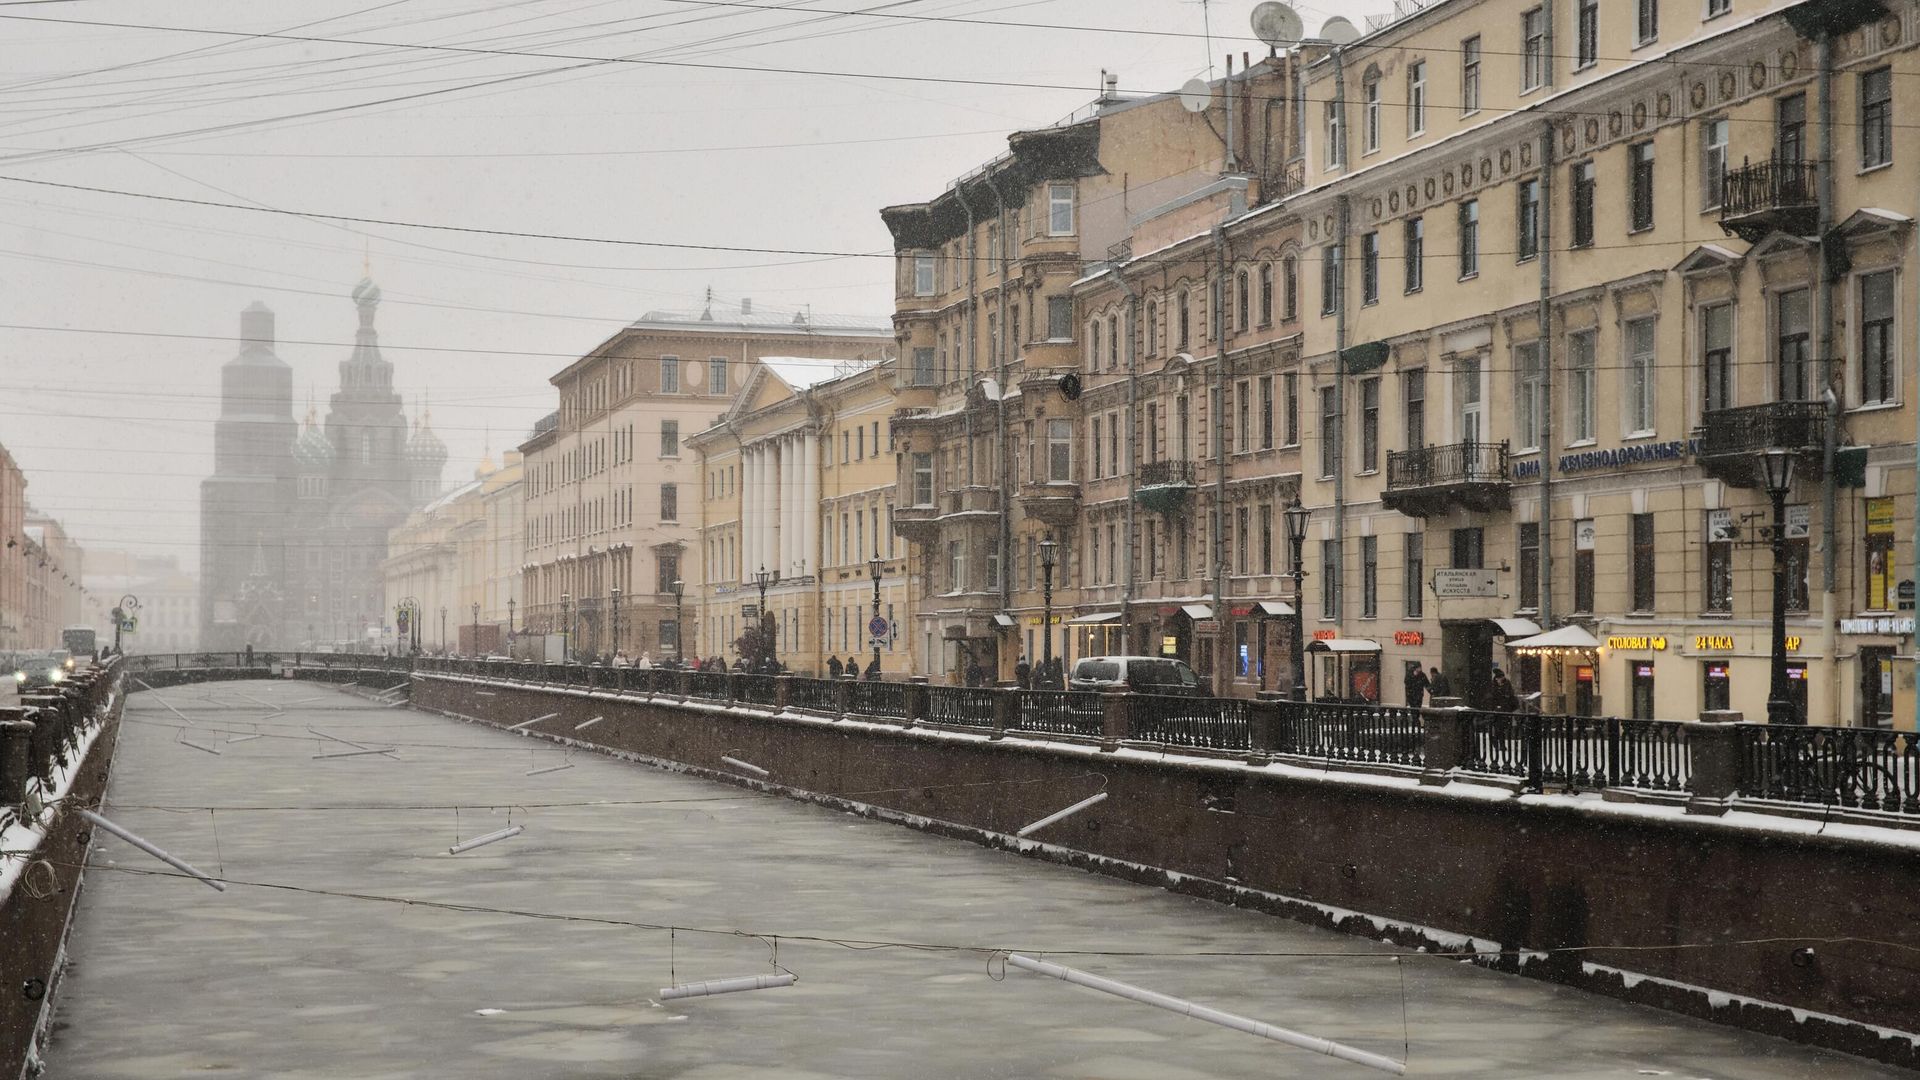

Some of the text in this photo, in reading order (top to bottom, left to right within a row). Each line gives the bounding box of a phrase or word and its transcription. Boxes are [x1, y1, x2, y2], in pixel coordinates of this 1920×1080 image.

[1512, 460, 1540, 478] АВИА
[1558, 439, 1682, 473] ЖЕЛЕЗНОДОРОЖНЫЕ
[1608, 636, 1648, 649] СТОЛОВАЯ
[1695, 636, 1733, 649] 24 ЧАСА
[1784, 637, 1801, 650] АР
